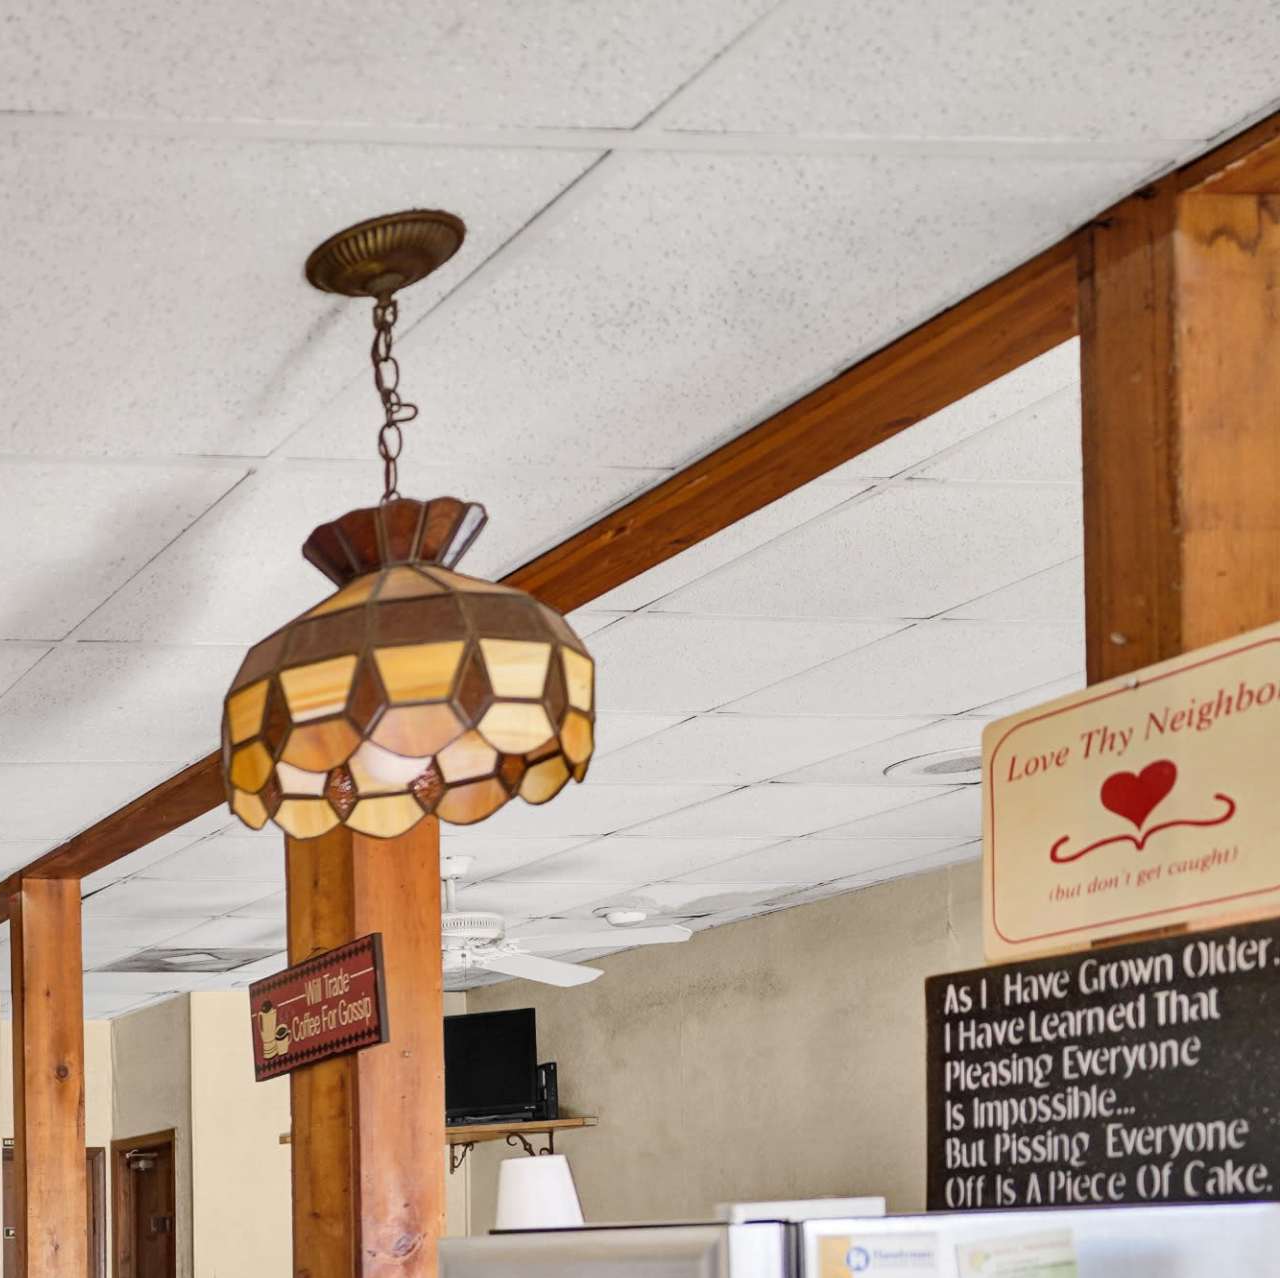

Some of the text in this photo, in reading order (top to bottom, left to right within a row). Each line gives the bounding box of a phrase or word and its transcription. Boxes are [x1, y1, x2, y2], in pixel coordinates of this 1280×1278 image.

[1006, 680, 1280, 783] Love Thy Neighbo
[1087, 867, 1133, 896] don't
[1136, 865, 1163, 888] get
[1168, 845, 1239, 879] caught)
[304, 967, 350, 1006] Will Trade
[944, 983, 972, 1016] As
[981, 979, 987, 1010] I
[1004, 968, 1070, 1006] Have
[1079, 953, 1174, 995] Grown
[291, 991, 372, 1042] Coffee For Gossip
[945, 986, 1221, 1053] I Have Learned That
[945, 1035, 1202, 1092] Pleasing Everyone
[946, 1099, 965, 1132] Is
[946, 1117, 1250, 1169] But Pissing Everyone
[945, 1159, 1274, 1209] Off Is A Piece Of Cake.
